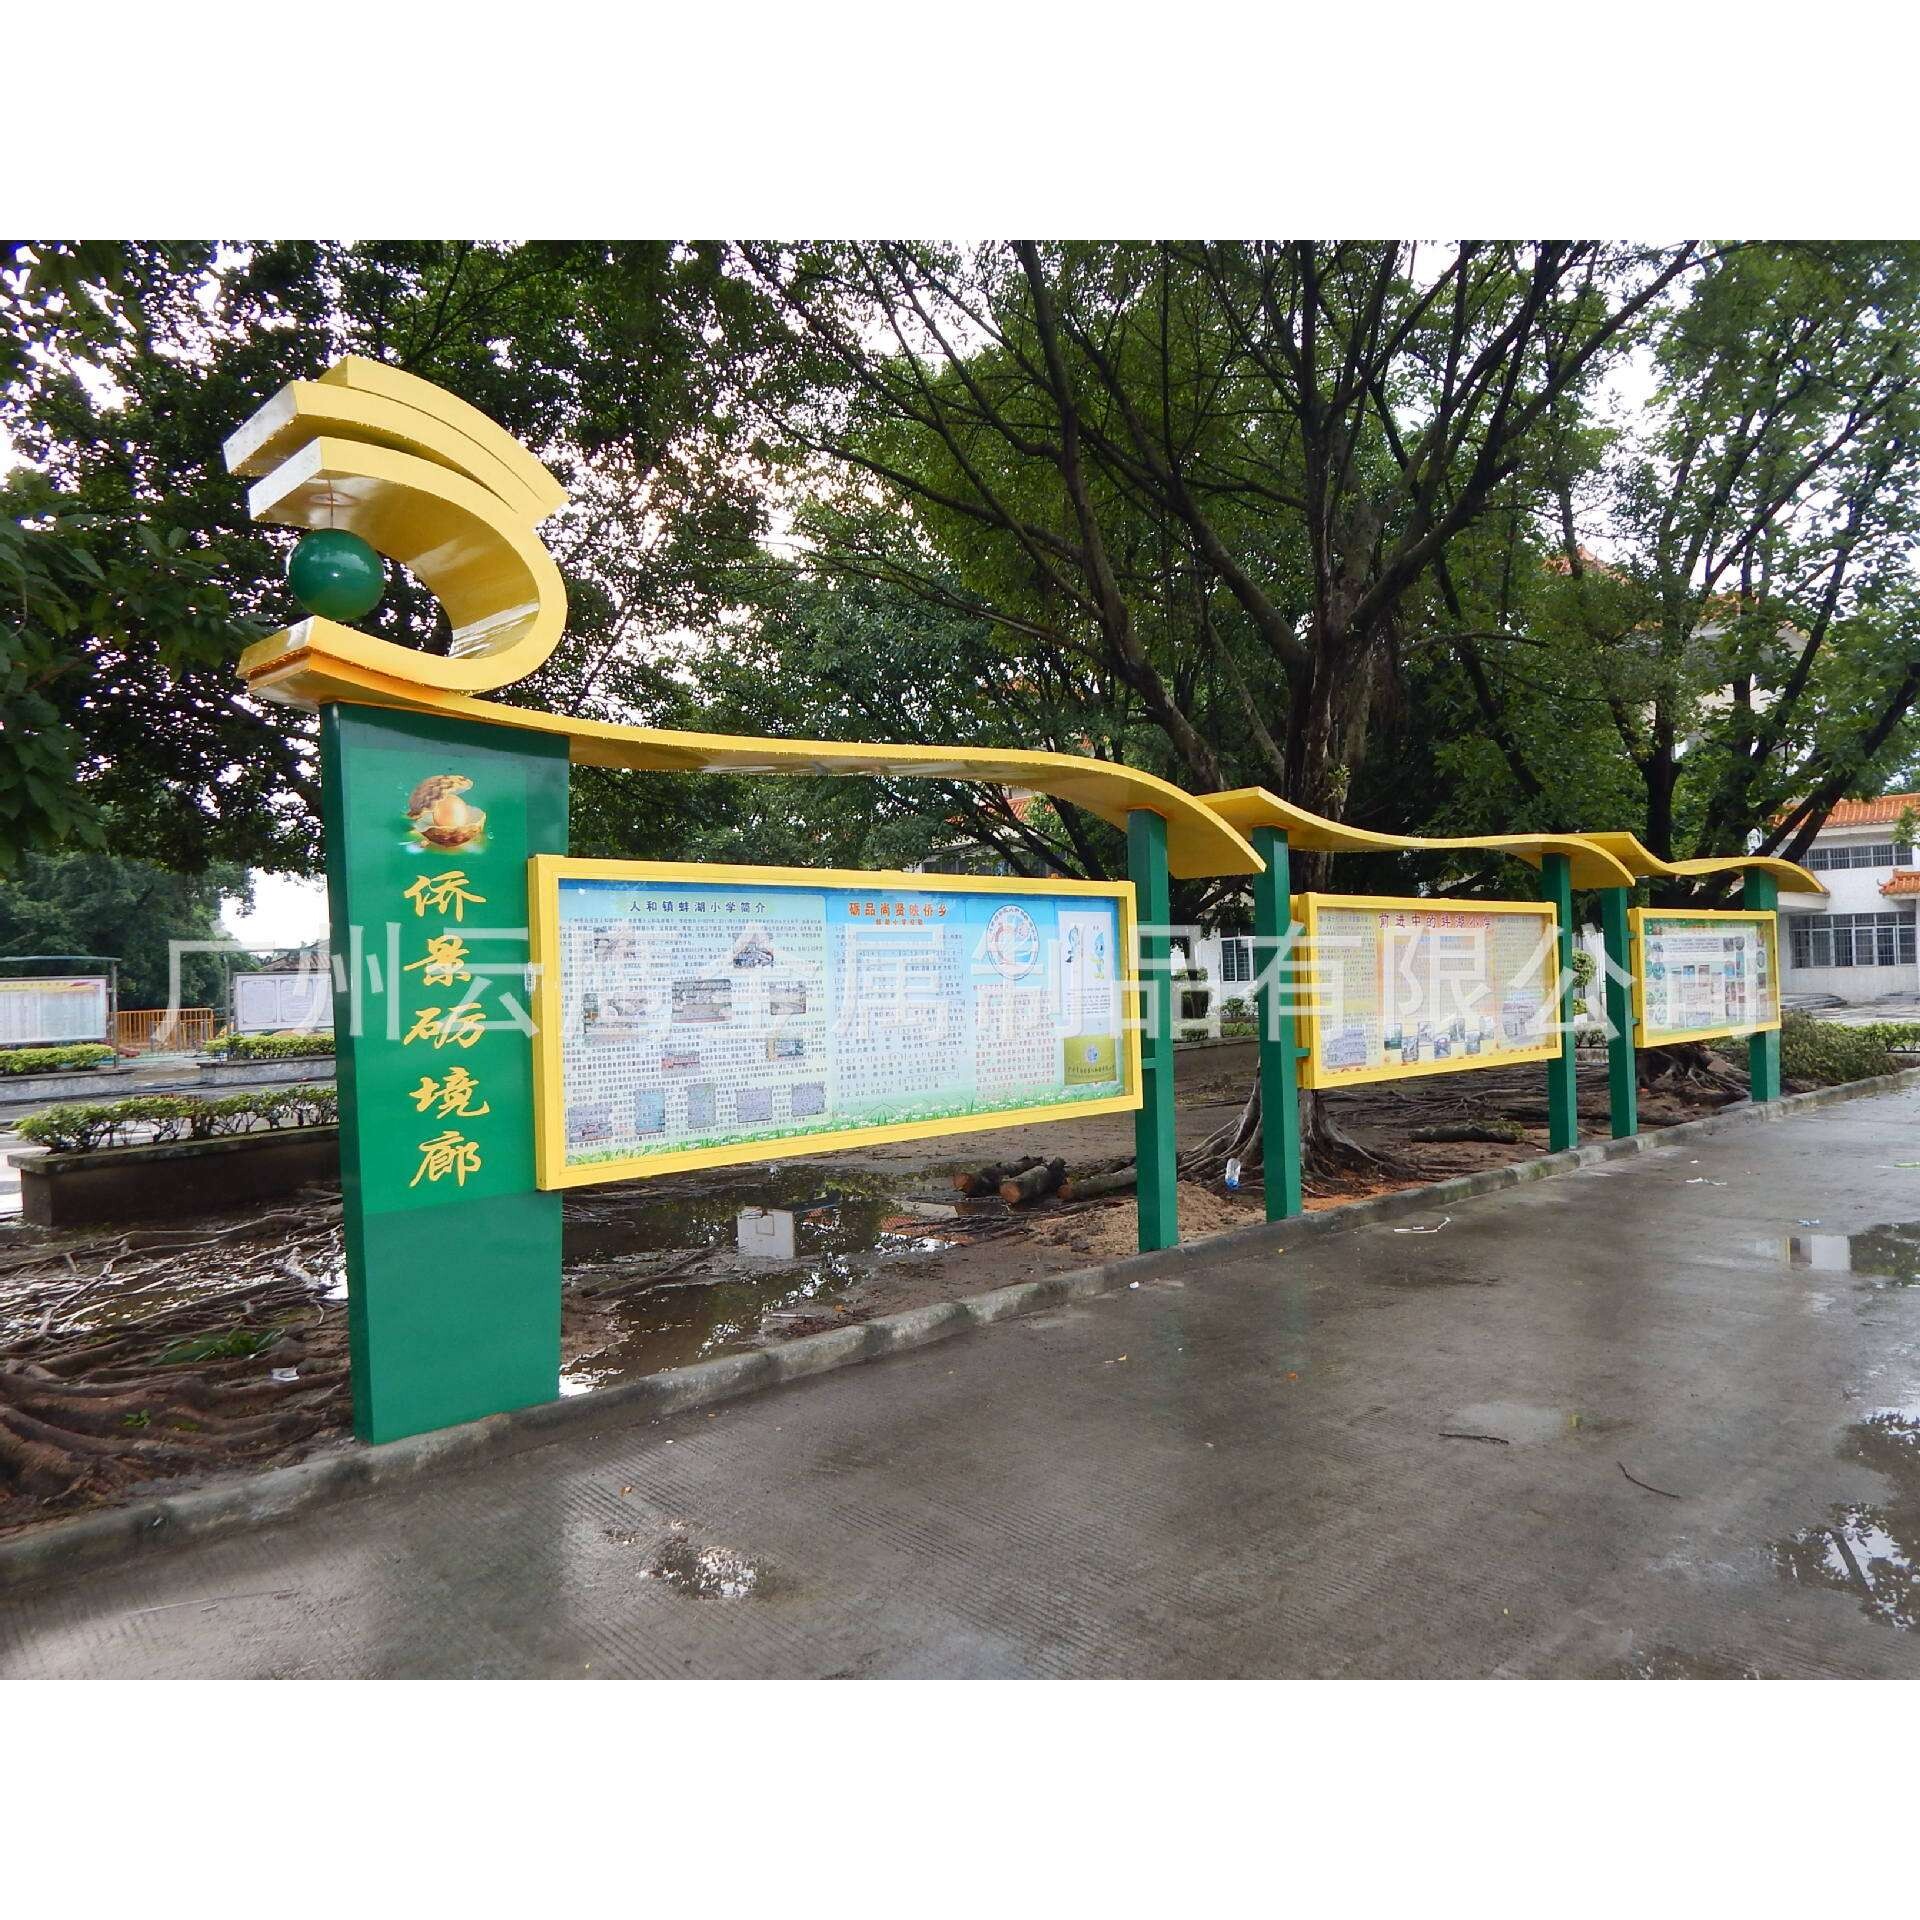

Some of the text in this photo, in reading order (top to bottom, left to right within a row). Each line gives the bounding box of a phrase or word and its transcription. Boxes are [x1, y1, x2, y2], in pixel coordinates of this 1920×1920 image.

[630, 900, 766, 913] 人和镇蚌湖小学简介
[403, 870, 490, 1188] 侨景砺境廊
